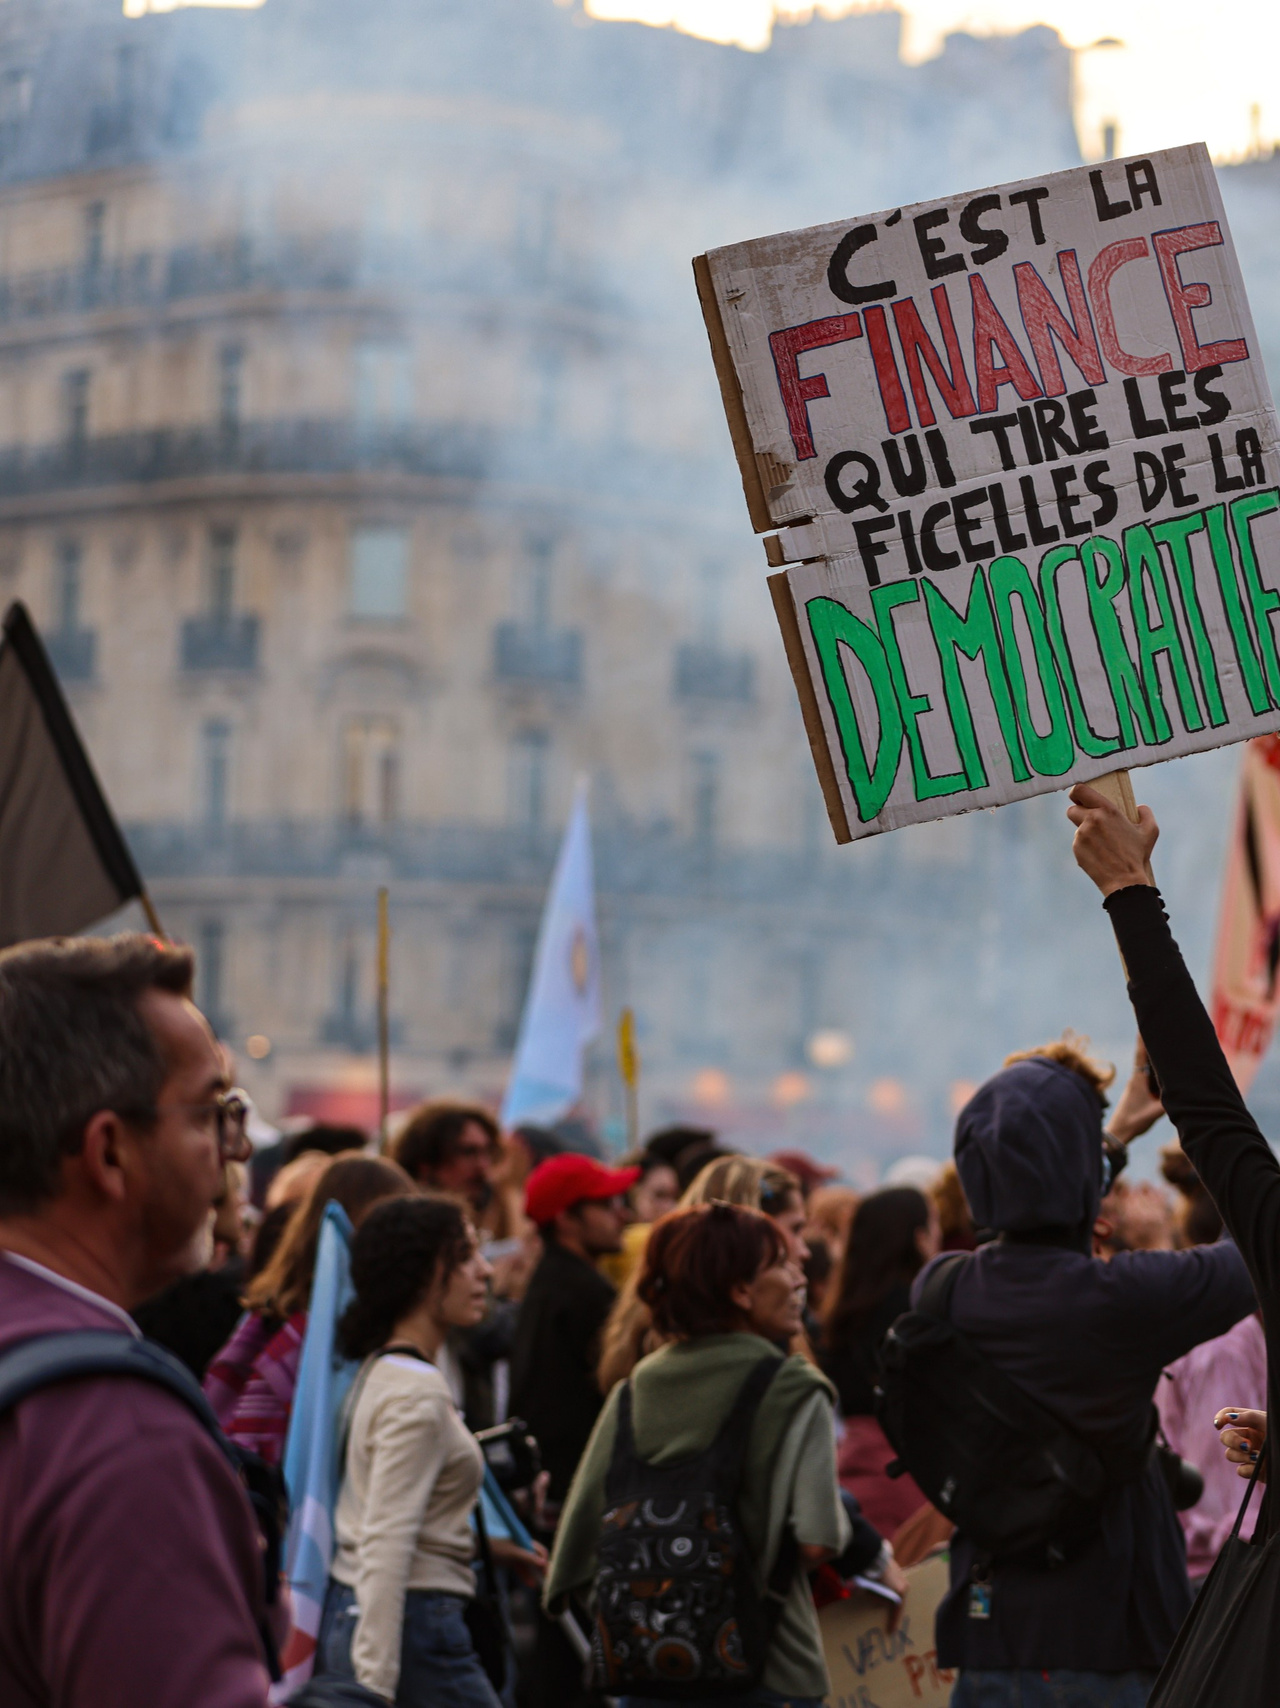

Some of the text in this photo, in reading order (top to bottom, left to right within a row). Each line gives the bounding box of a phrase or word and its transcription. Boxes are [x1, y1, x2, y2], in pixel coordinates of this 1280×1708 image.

[826, 159, 1162, 305] C'EST LA
[769, 220, 1249, 461] FINANCE
[824, 365, 1231, 513] QUI TIRE LES
[852, 428, 1266, 586] FICELLES DE LA
